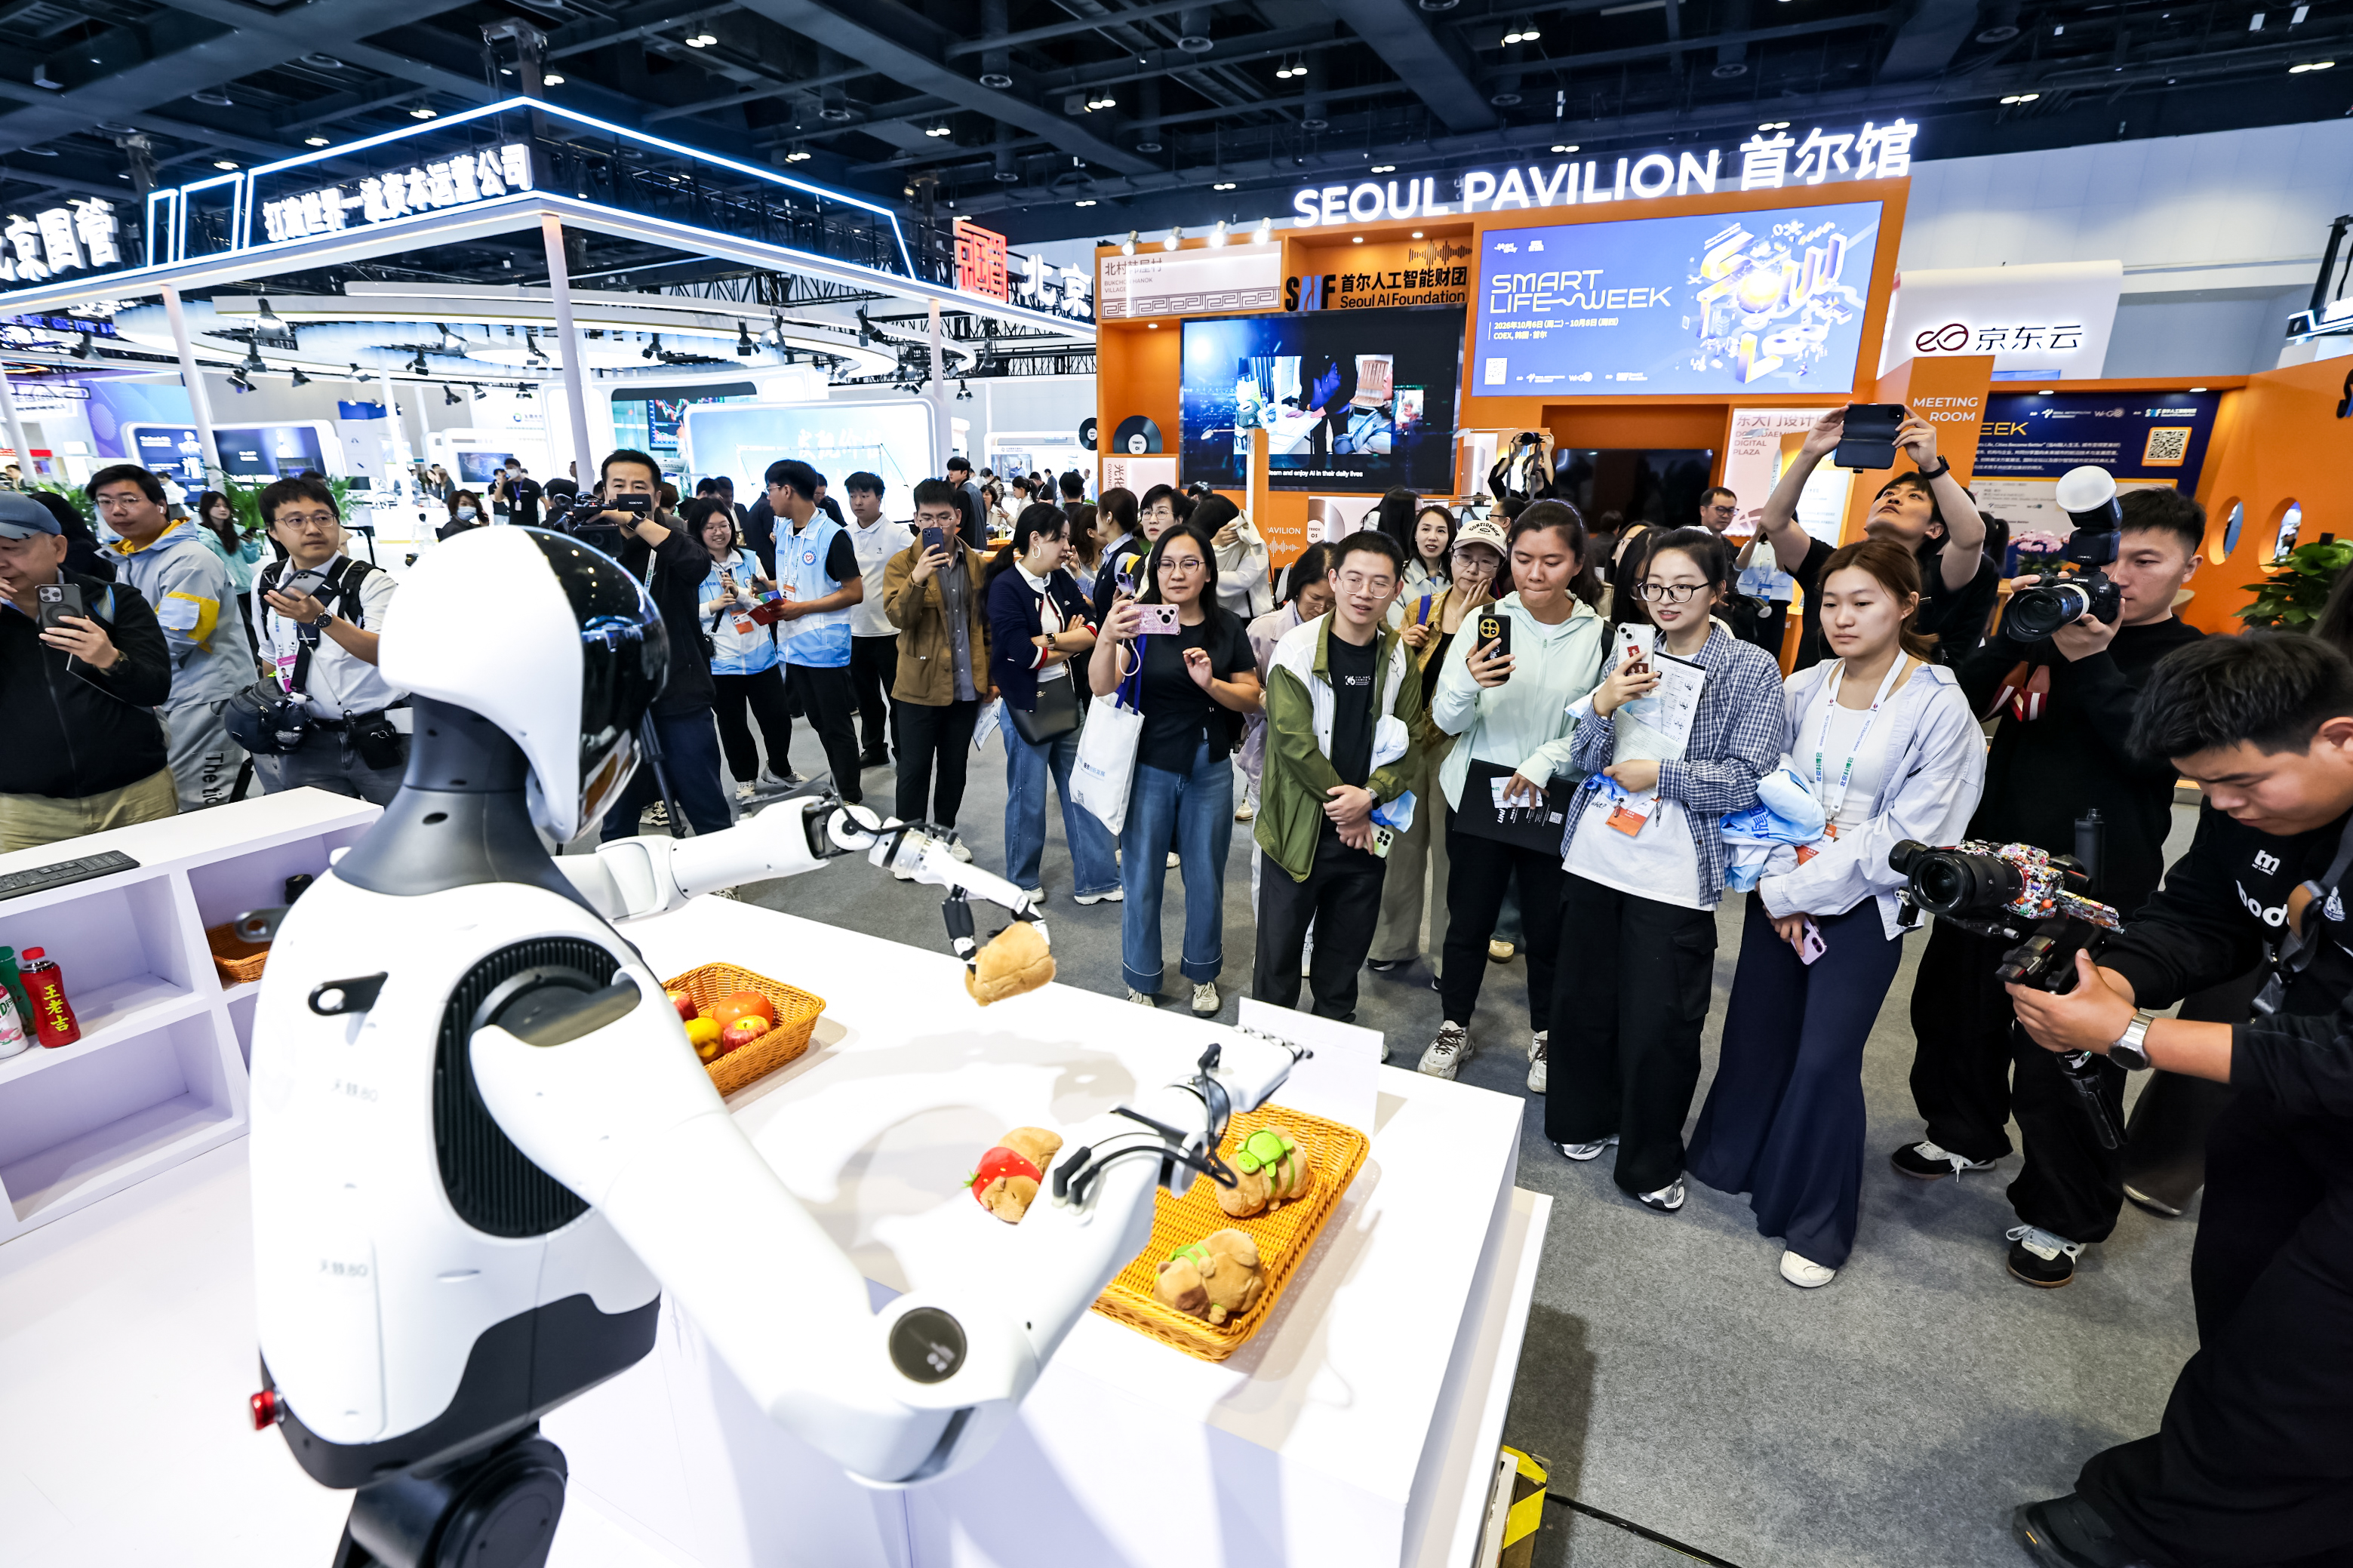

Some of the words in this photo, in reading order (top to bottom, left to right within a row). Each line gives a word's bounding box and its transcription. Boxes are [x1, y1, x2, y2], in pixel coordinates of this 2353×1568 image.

[1293, 176, 1450, 228] SEOUL
[1463, 149, 1720, 213] PAVILION
[1739, 118, 1918, 192] 首尔馆
[263, 143, 533, 242] 打造世界一流资本运营公司
[1019, 253, 1093, 317] 北京
[1341, 266, 1468, 293] 首尔人工智能财团
[1491, 269, 1604, 294] SMART
[1340, 294, 1375, 309] Seoul
[1377, 293, 1390, 306] AI
[1393, 290, 1466, 306] Foundation
[1490, 291, 1553, 314] LIFE
[1579, 286, 1673, 310] WEEK
[1976, 325, 2083, 352] 京东云
[1913, 397, 1979, 407] MEETING
[1736, 414, 1824, 427] 东大门设计
[1929, 411, 1976, 422] ROOM
[1267, 527, 1302, 535] AVILION
[202, 752, 224, 783] The
[2235, 880, 2290, 927] bod
[44, 984, 69, 1032] 王老吉
